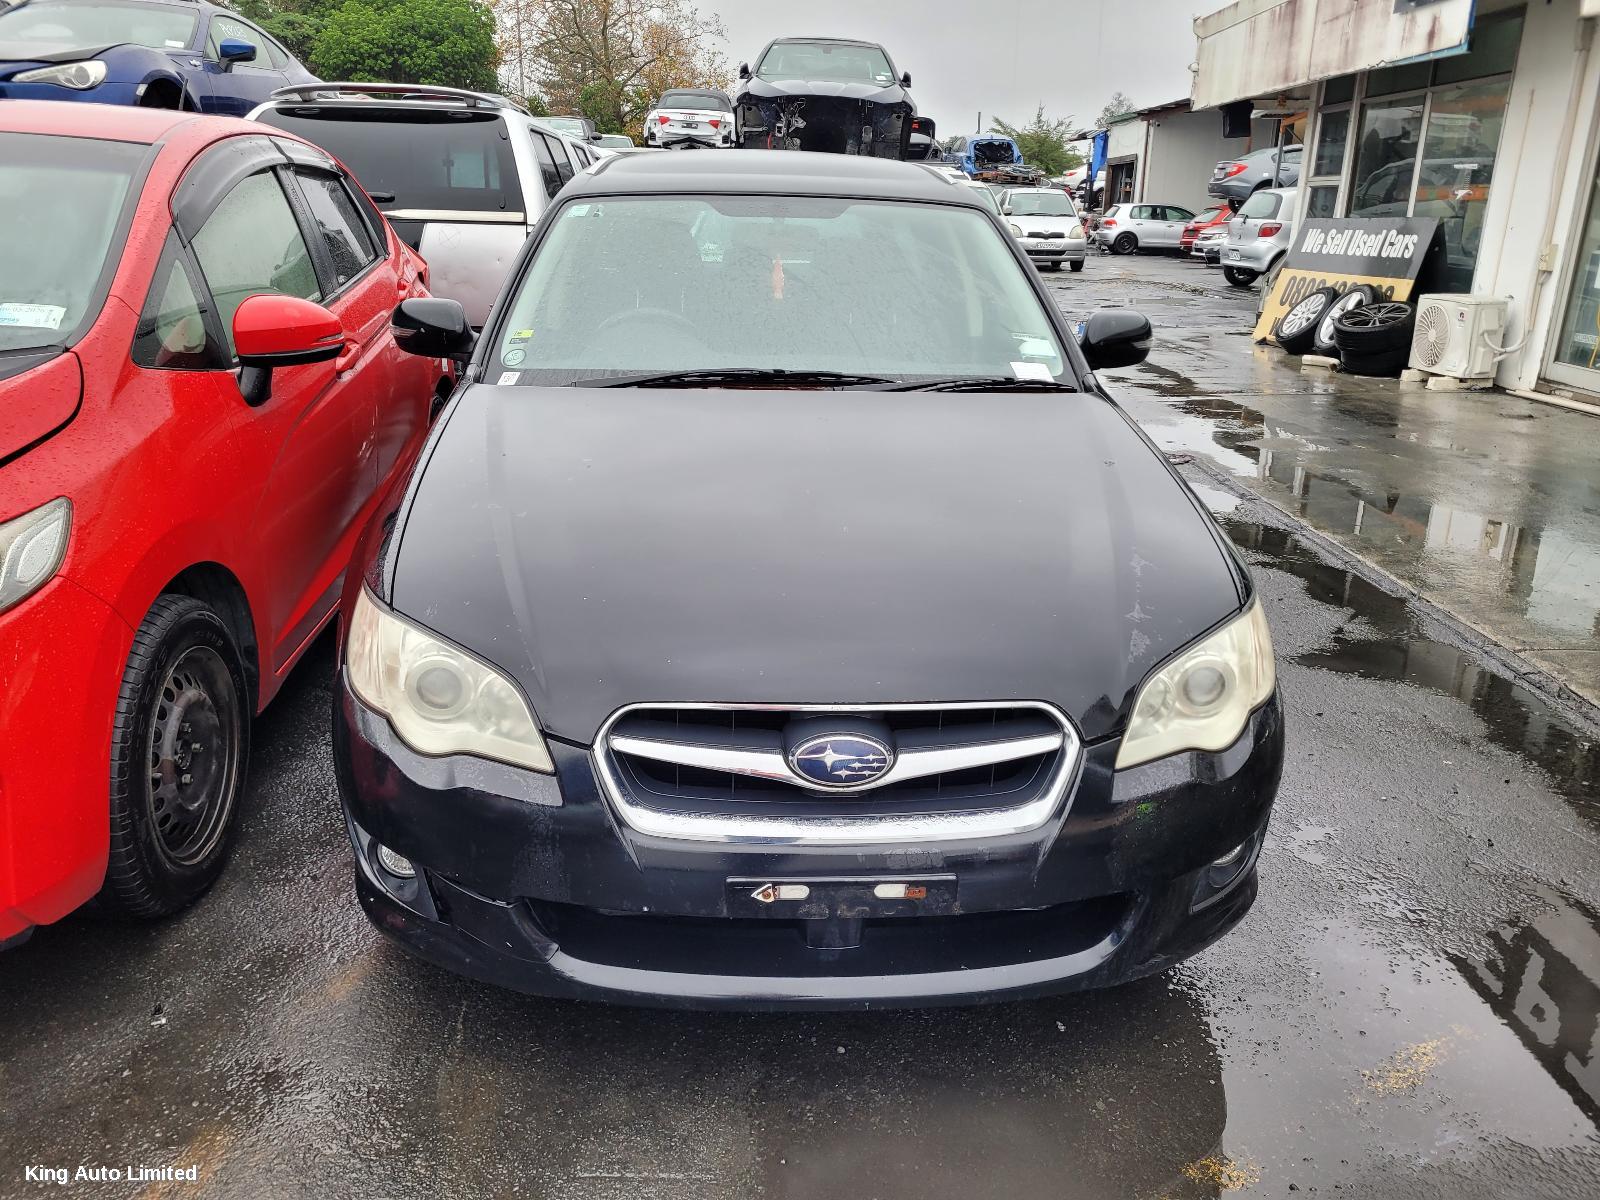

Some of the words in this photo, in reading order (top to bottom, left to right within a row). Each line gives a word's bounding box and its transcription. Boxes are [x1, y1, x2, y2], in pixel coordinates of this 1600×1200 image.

[1300, 228, 1325, 254] We
[1321, 228, 1354, 255] Sell
[1347, 229, 1388, 257] Used
[1381, 229, 1419, 259] Cars
